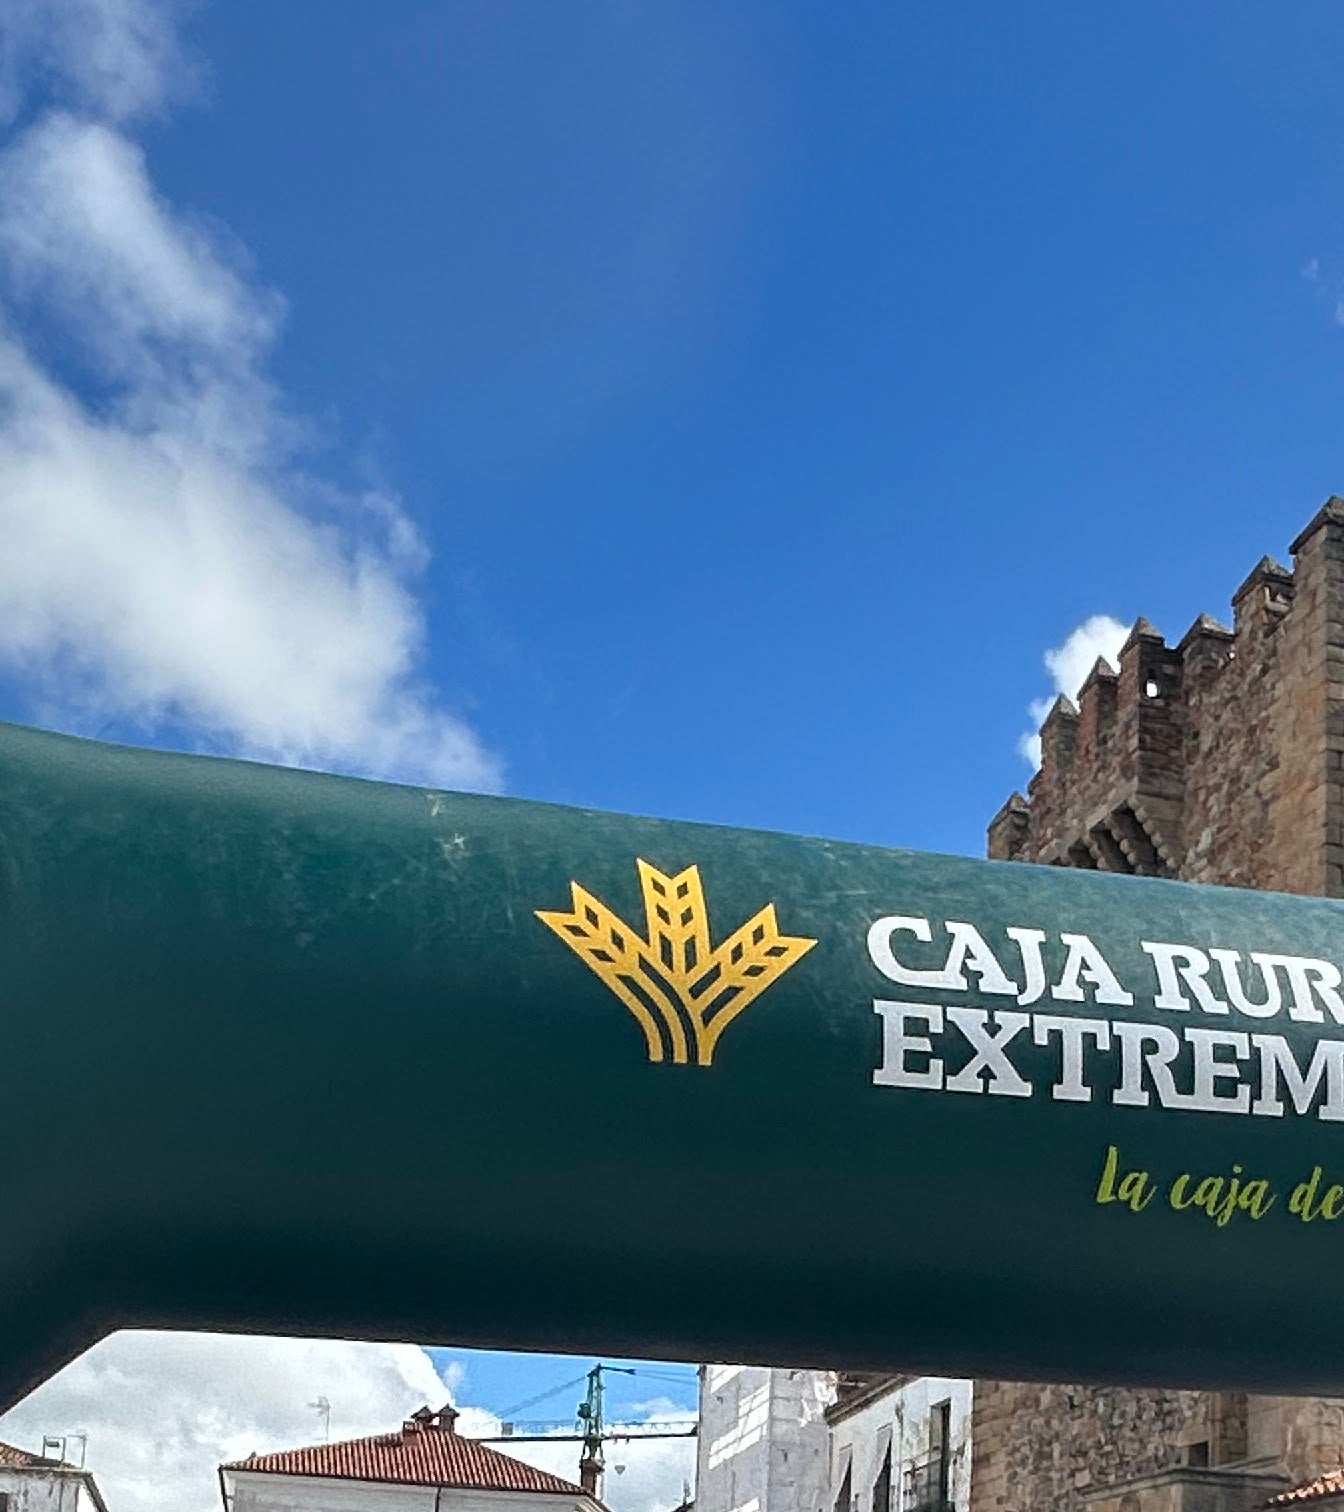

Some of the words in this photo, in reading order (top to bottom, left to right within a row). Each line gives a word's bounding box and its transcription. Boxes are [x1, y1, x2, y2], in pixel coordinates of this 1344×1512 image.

[867, 916, 1134, 1006] CAJA
[1096, 1146, 1157, 1212] La
[1170, 1165, 1278, 1227] caja
